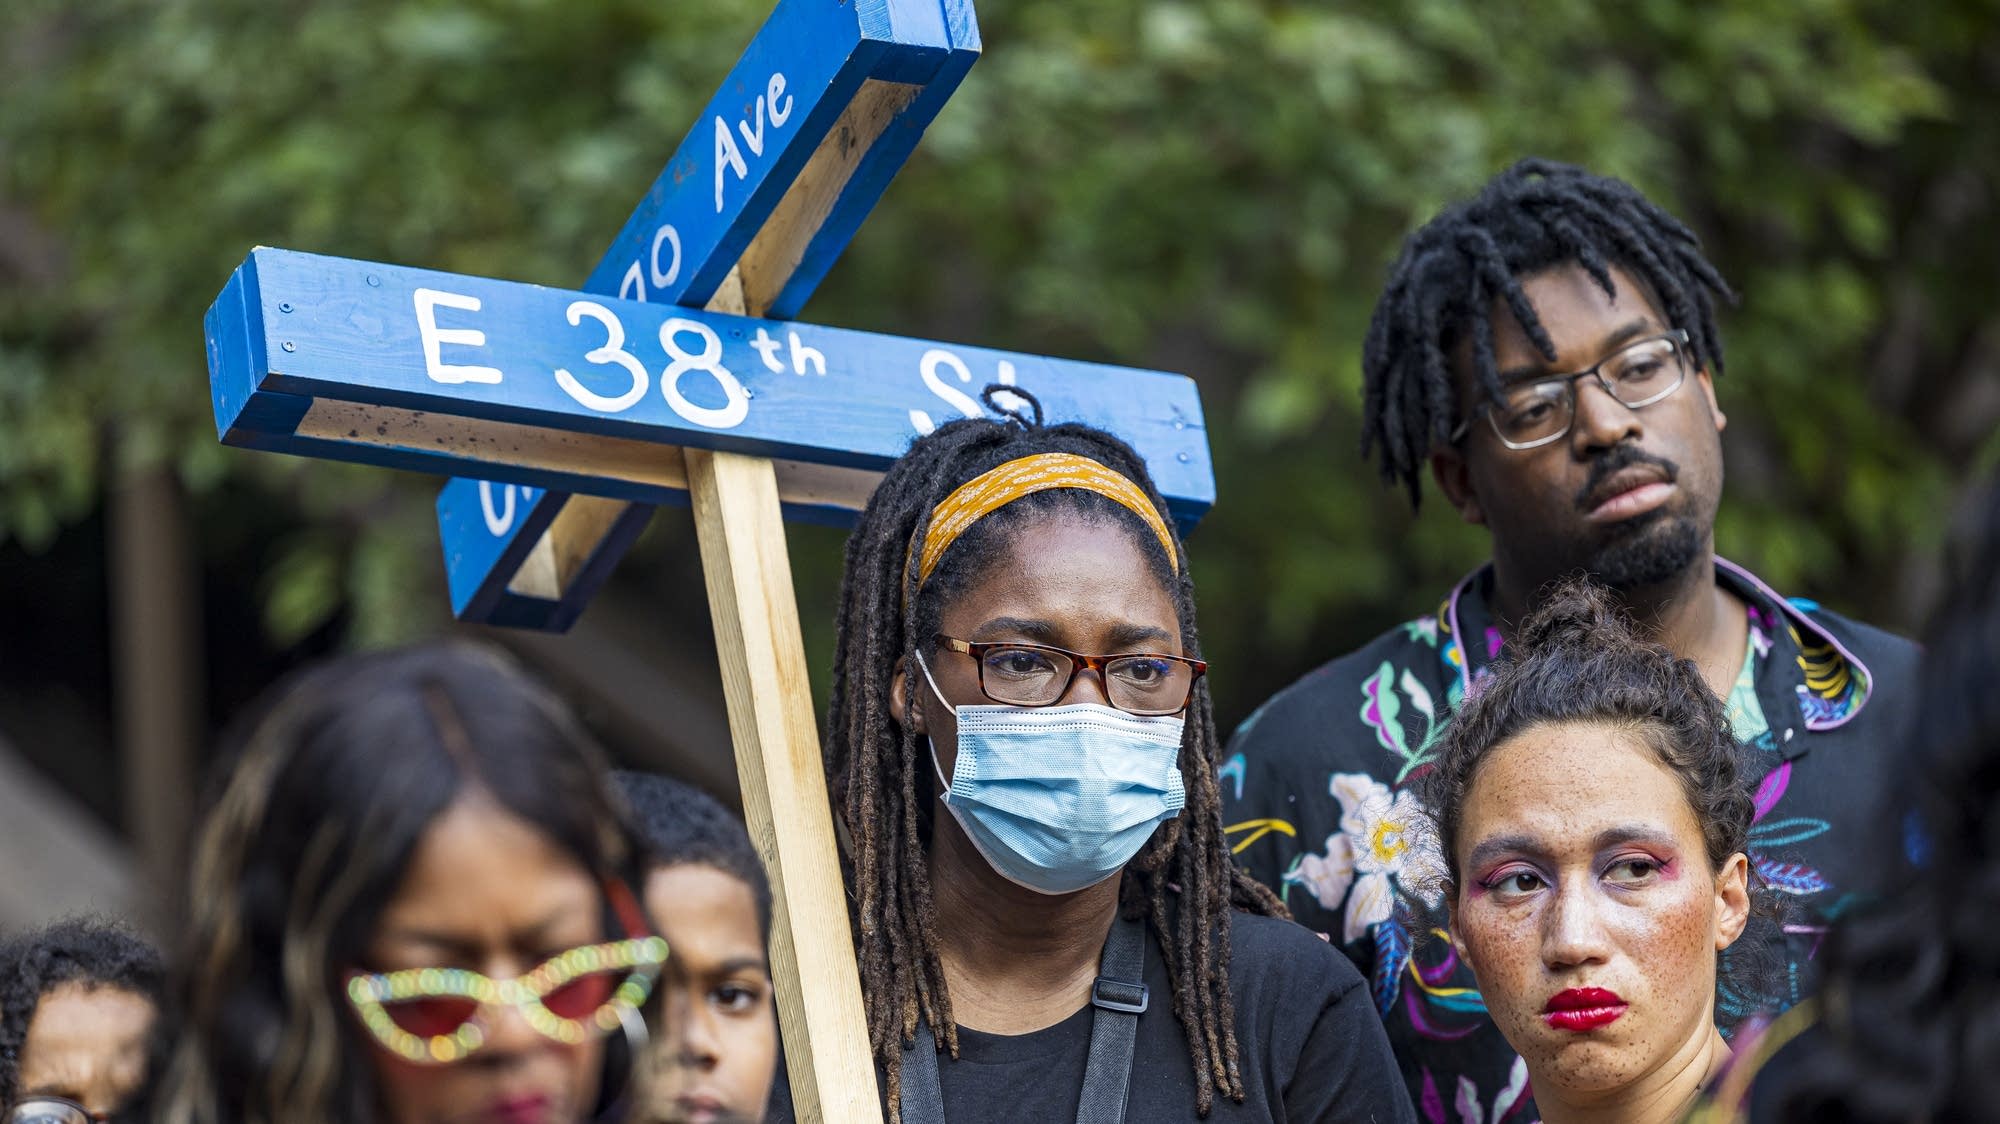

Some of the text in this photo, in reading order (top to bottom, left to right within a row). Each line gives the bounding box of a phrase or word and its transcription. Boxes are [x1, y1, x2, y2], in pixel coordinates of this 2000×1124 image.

[714, 72, 793, 213] Ave
[413, 288, 503, 384] E
[554, 300, 827, 428] 38th
